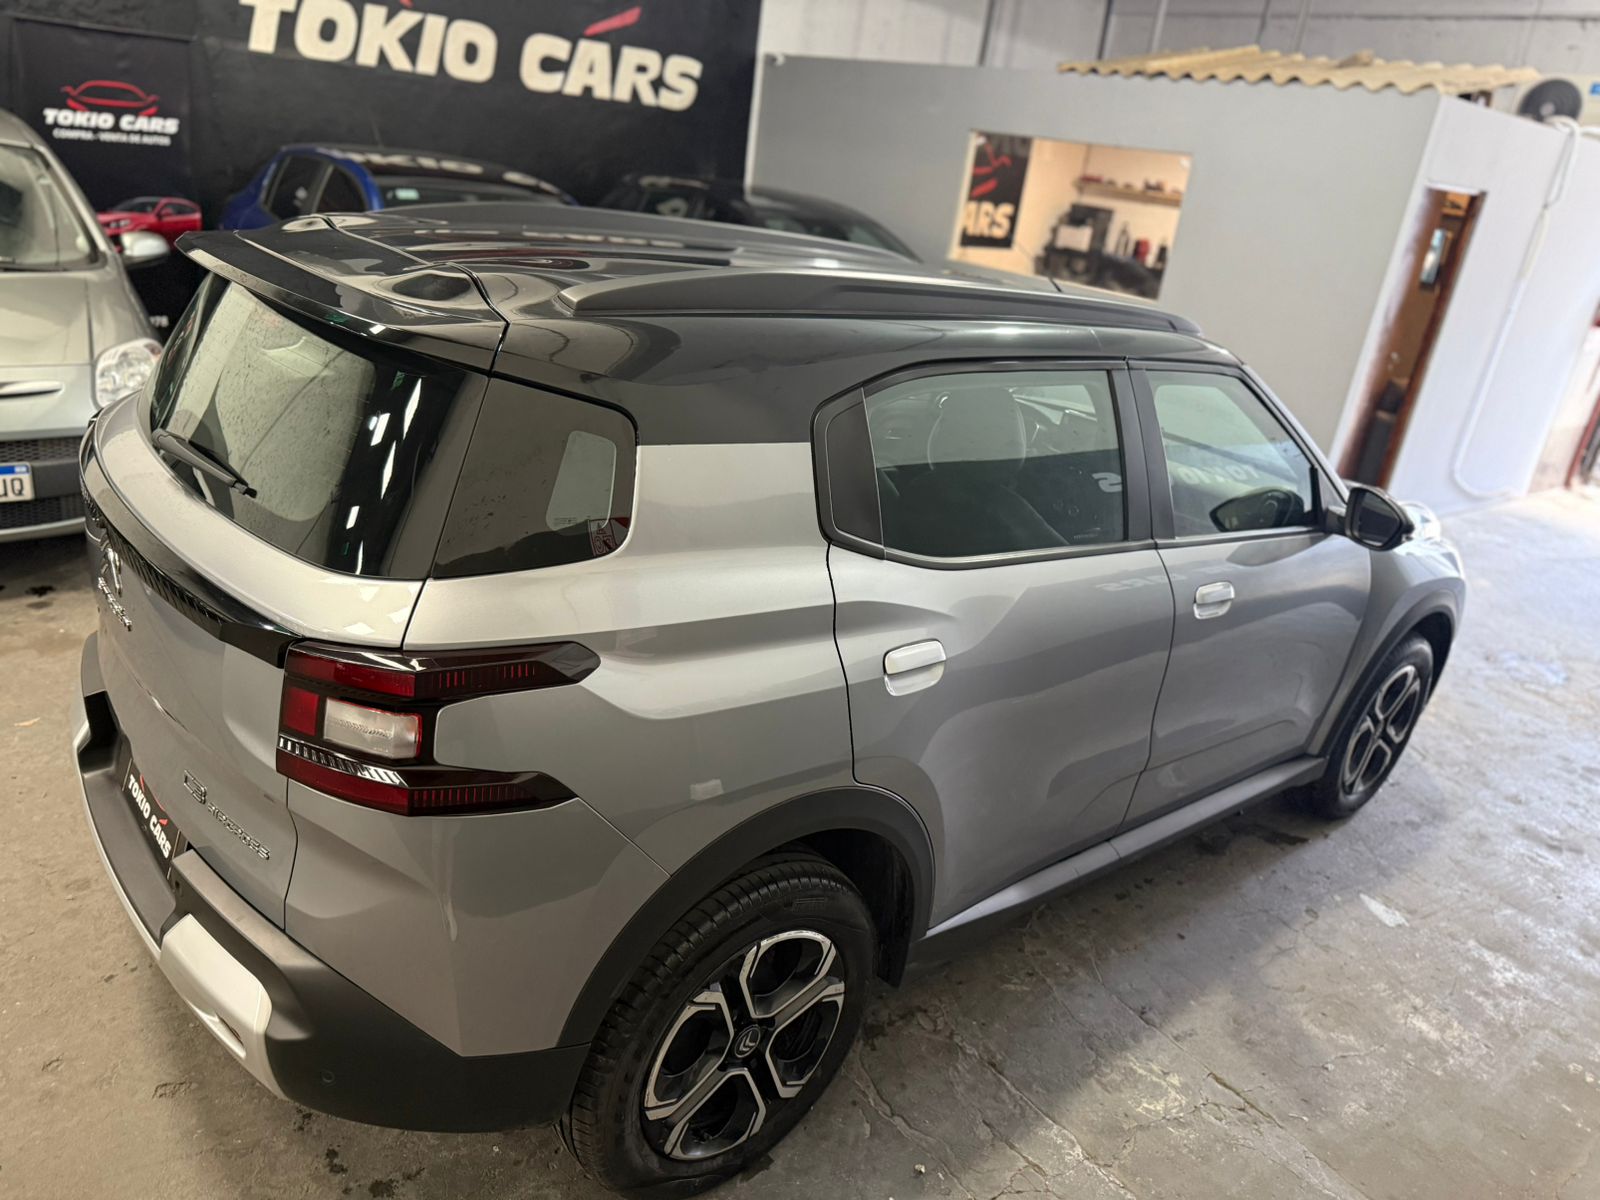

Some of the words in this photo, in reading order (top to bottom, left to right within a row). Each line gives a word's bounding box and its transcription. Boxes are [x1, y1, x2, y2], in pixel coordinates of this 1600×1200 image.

[239, 0, 498, 83] TOKIO
[519, 32, 703, 112] CARS
[43, 107, 115, 130] TOKIO
[119, 114, 180, 135] CARS
[129, 774, 151, 819] TOKIO
[150, 814, 172, 859] CARS
